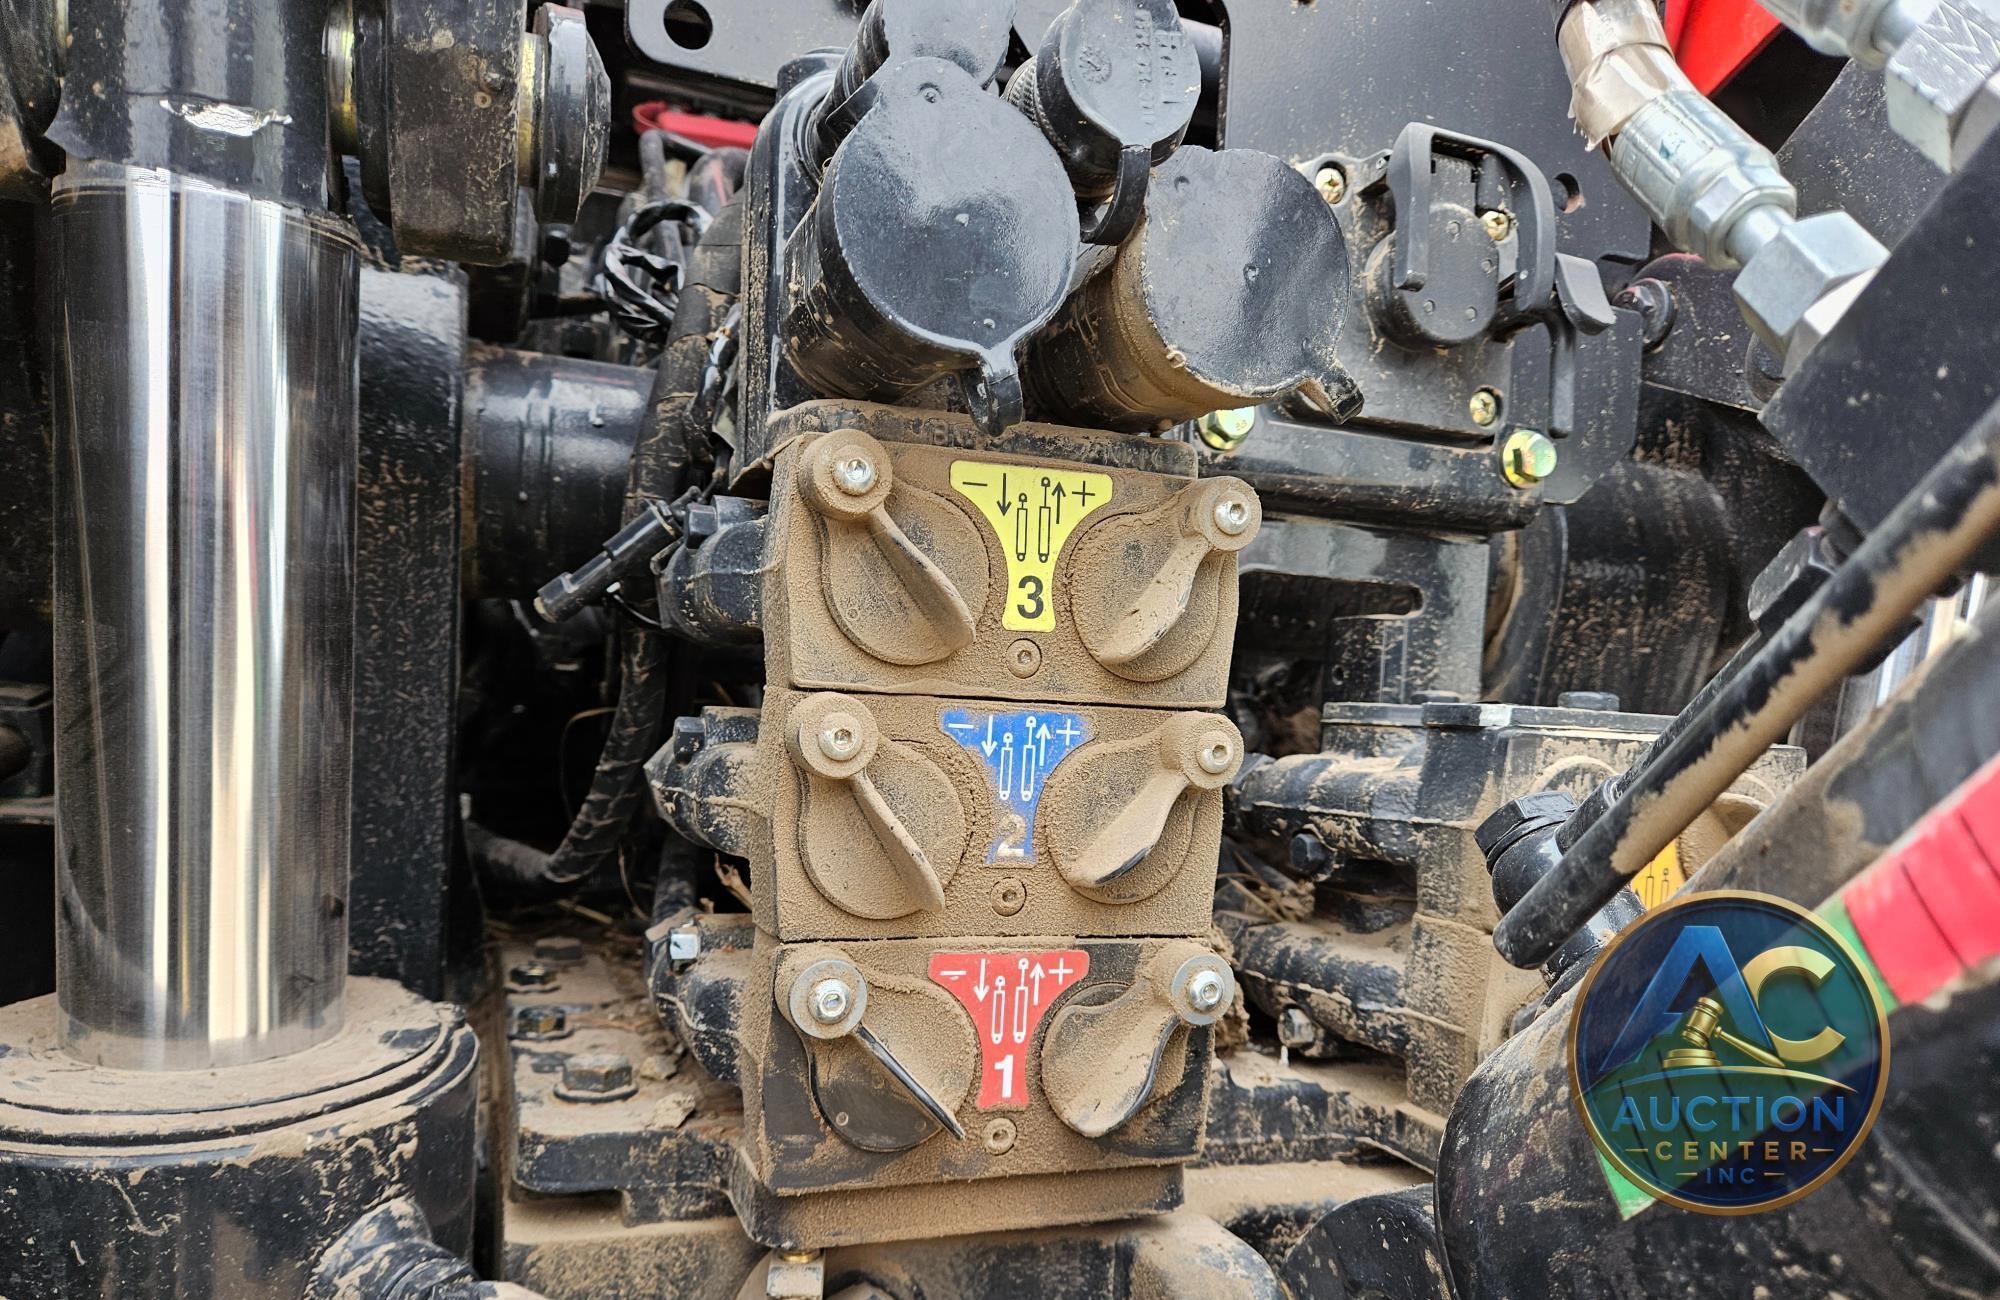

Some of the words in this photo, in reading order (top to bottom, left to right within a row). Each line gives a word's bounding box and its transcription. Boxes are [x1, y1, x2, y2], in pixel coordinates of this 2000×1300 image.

[1017, 575, 1045, 620] 3
[997, 814, 1026, 857] 2
[994, 1054, 1013, 1098] 1
